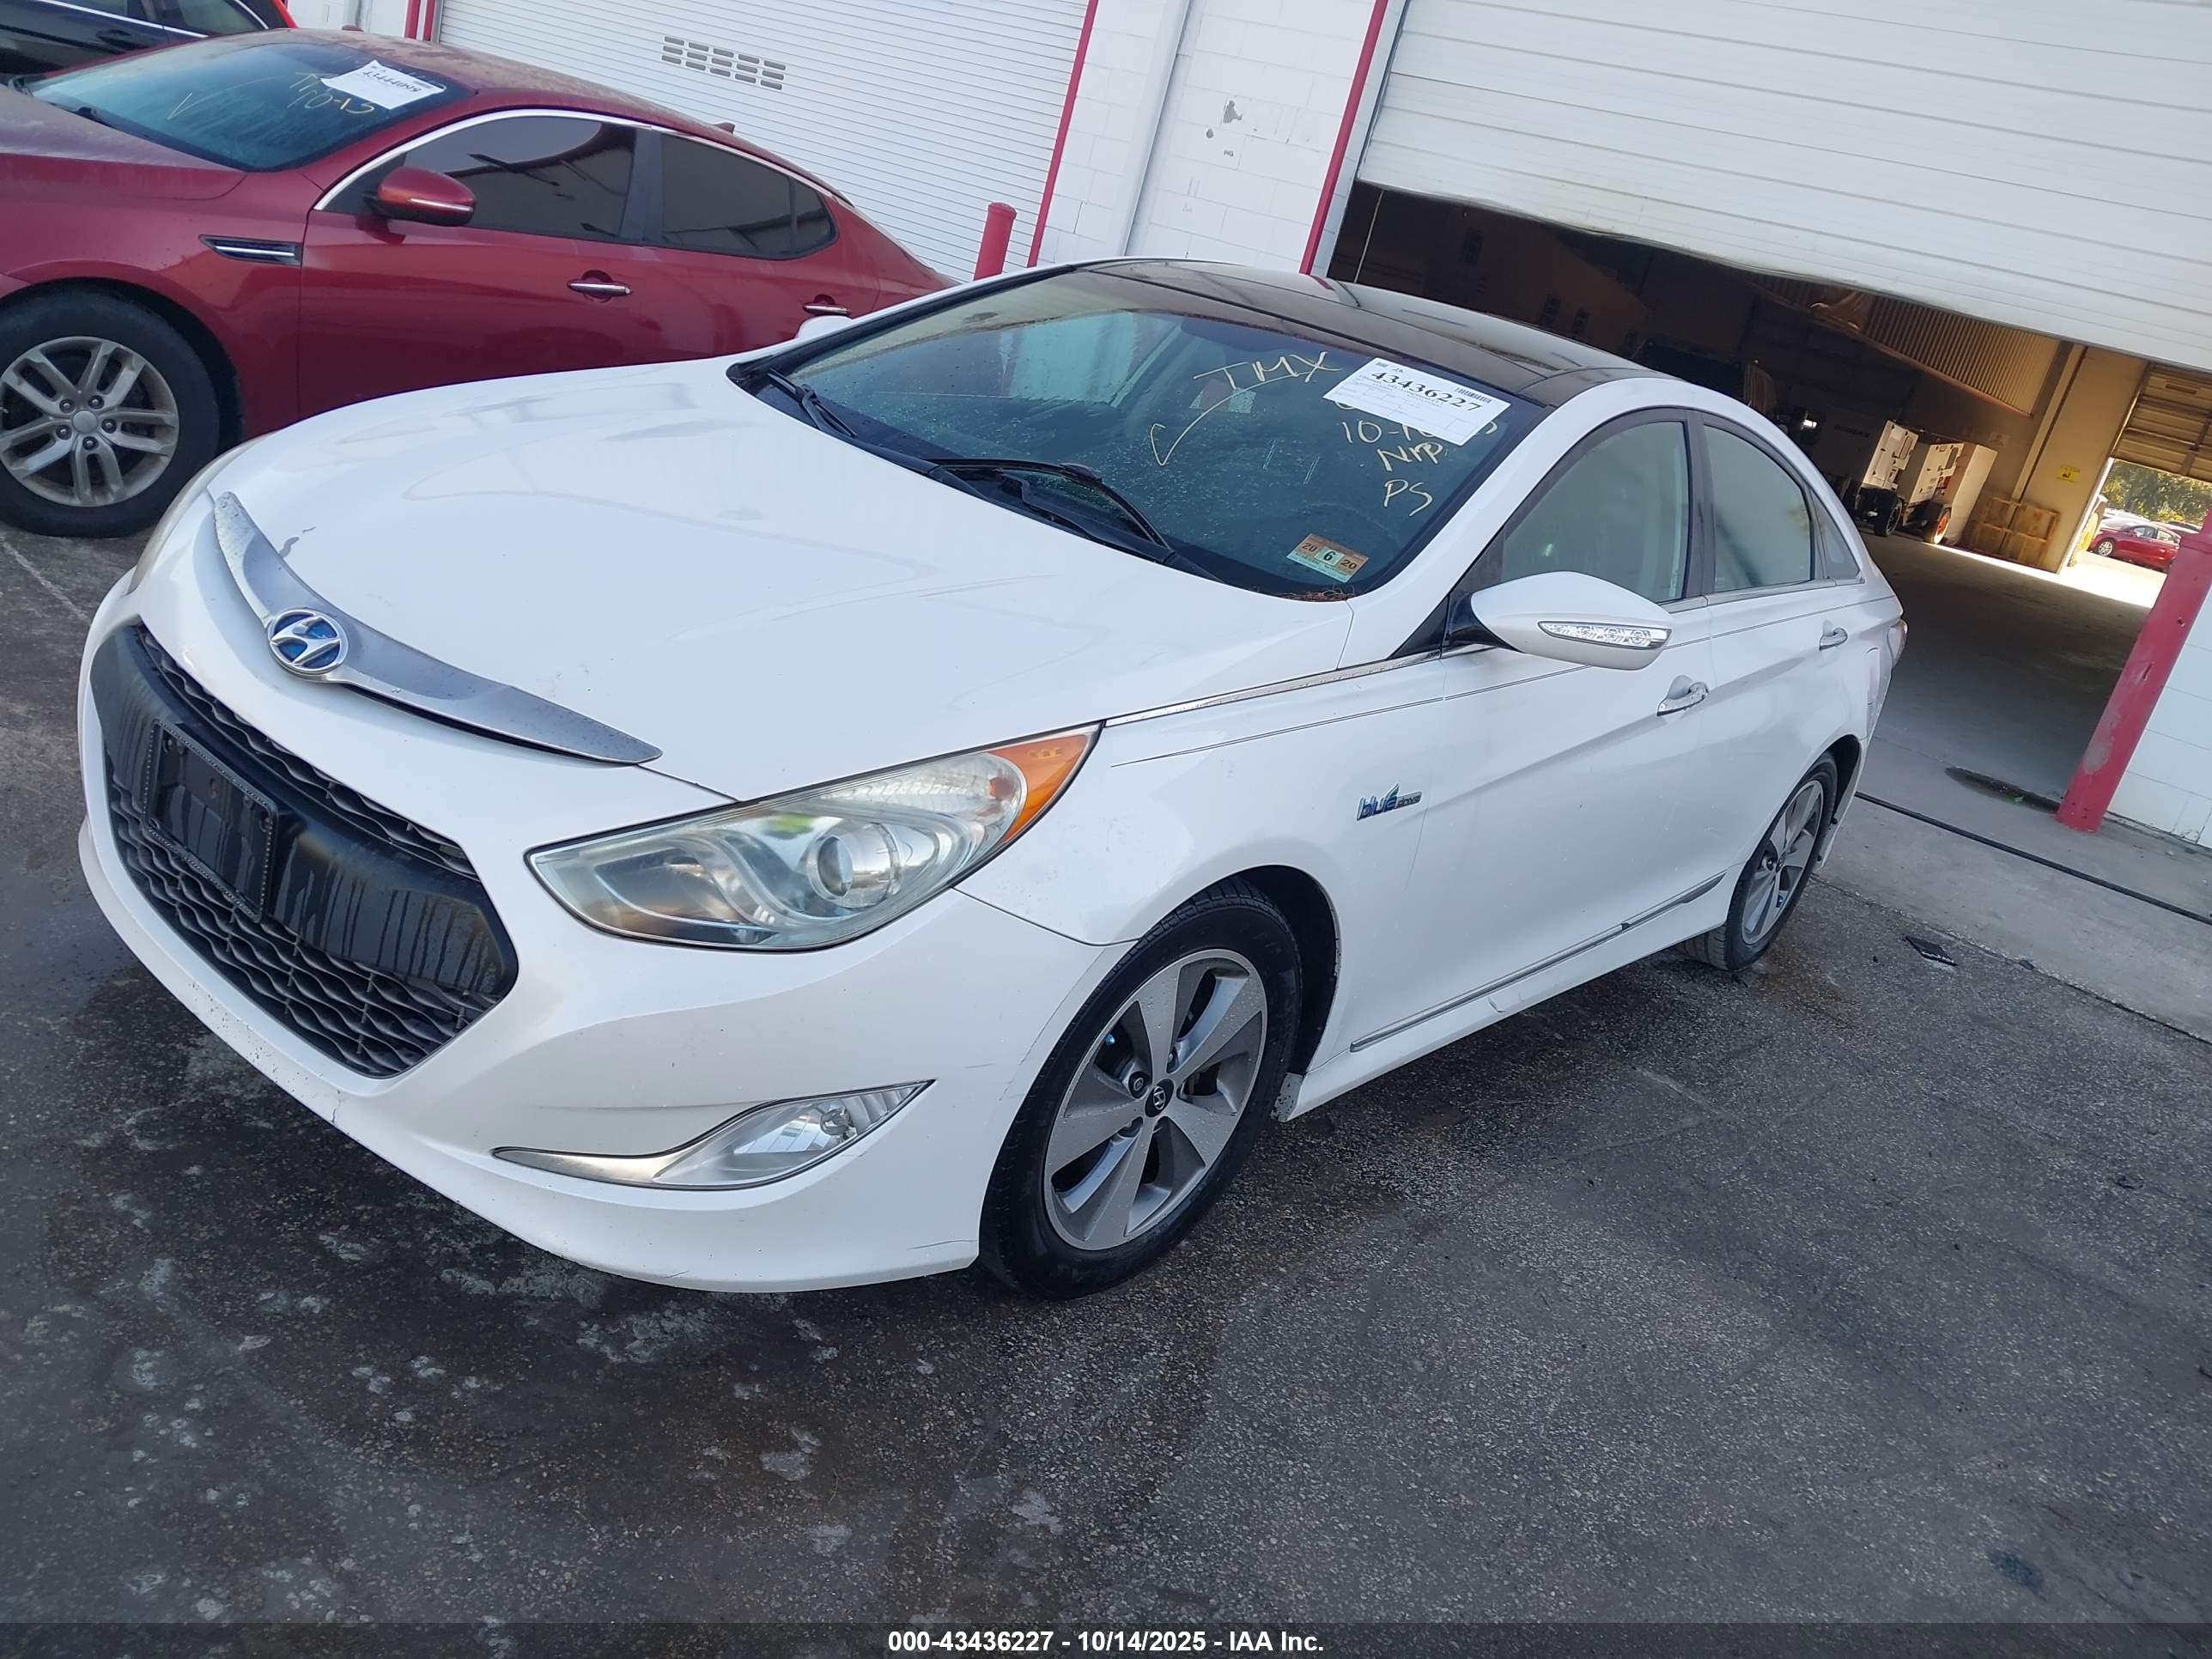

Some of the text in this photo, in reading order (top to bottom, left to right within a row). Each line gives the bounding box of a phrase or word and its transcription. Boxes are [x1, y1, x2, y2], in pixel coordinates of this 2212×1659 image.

[1371, 372, 1483, 411] 43436227
[1384, 479, 1433, 516] PS
[1302, 543, 1358, 570] 20 6 20
